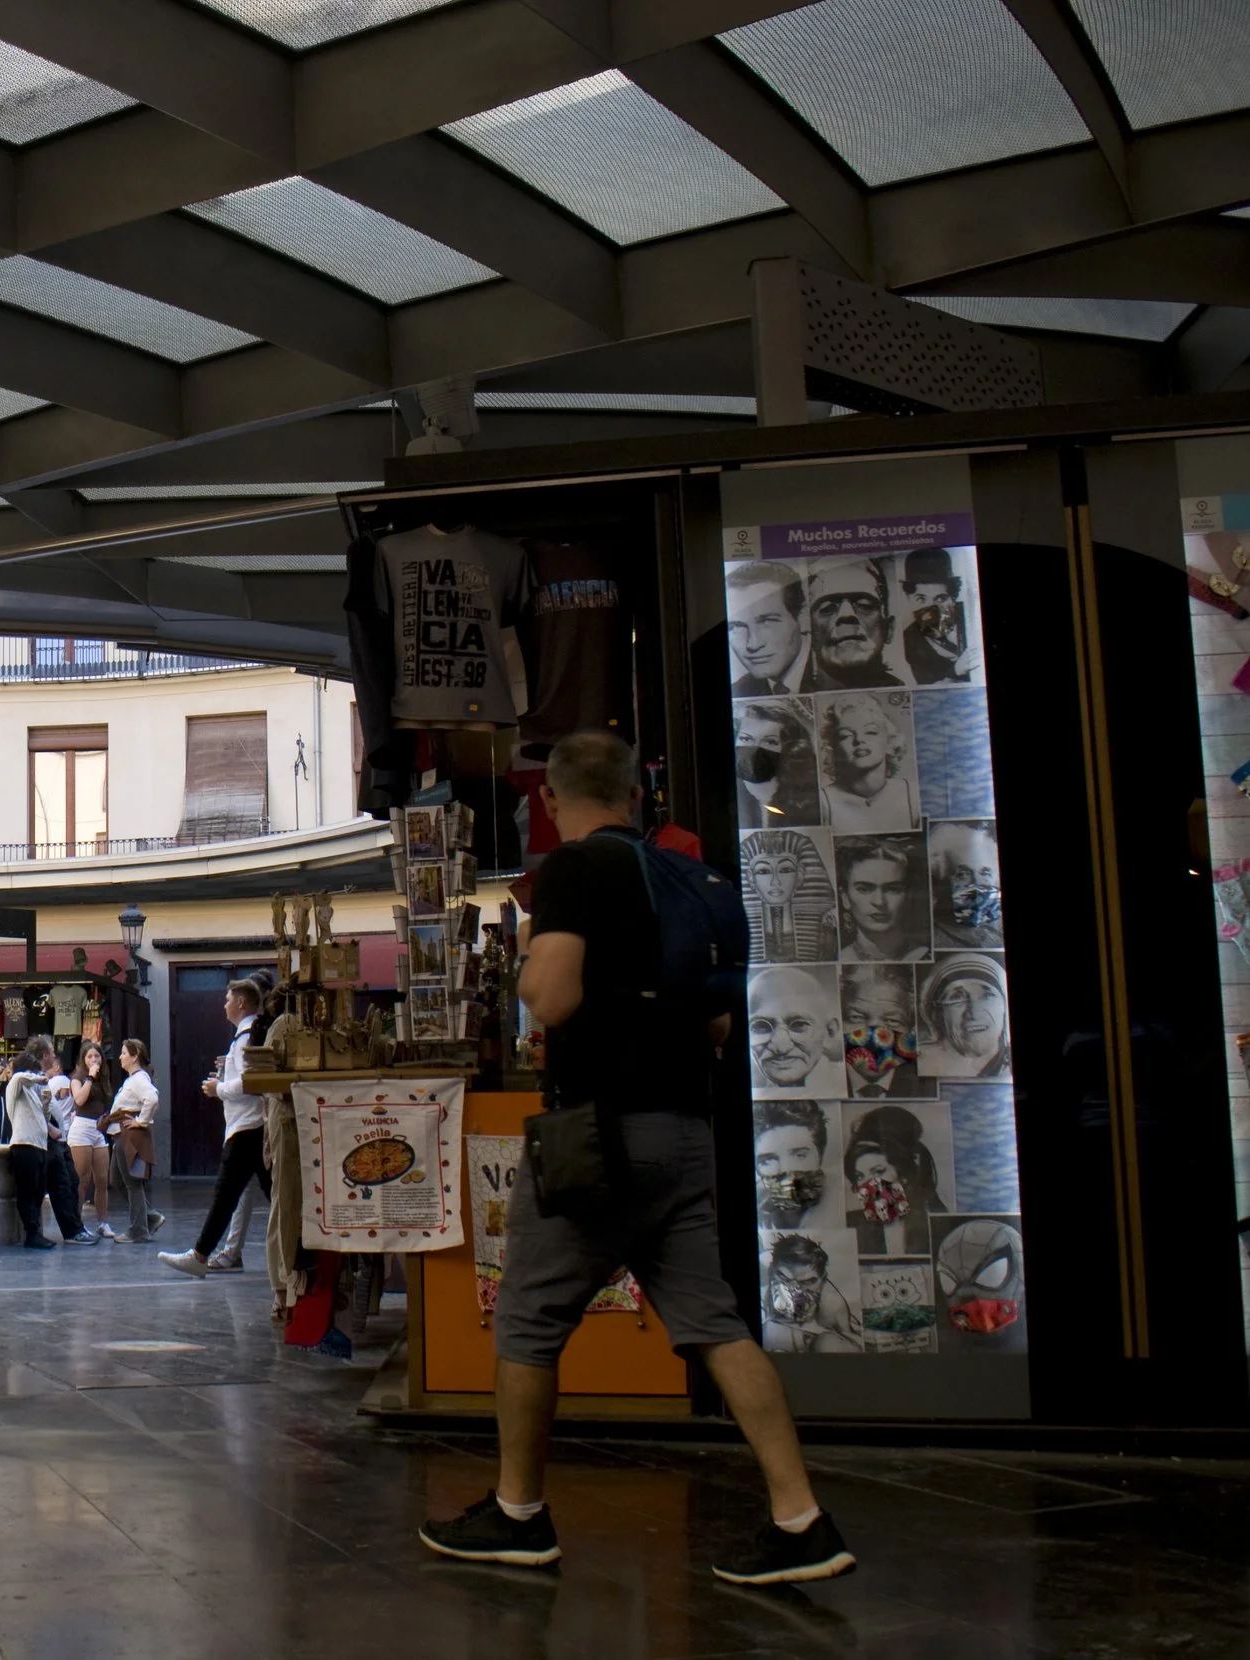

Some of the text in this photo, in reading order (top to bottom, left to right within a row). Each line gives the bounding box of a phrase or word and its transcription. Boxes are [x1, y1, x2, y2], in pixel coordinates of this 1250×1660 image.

[787, 520, 947, 543] Muchos Recuerdos
[889, 537, 934, 546] camisetas
[425, 559, 456, 586] VA
[422, 590, 459, 618] LEN
[421, 621, 486, 651] CIA
[361, 1117, 399, 1127] VALENCIA
[354, 1127, 391, 1144] Paella
